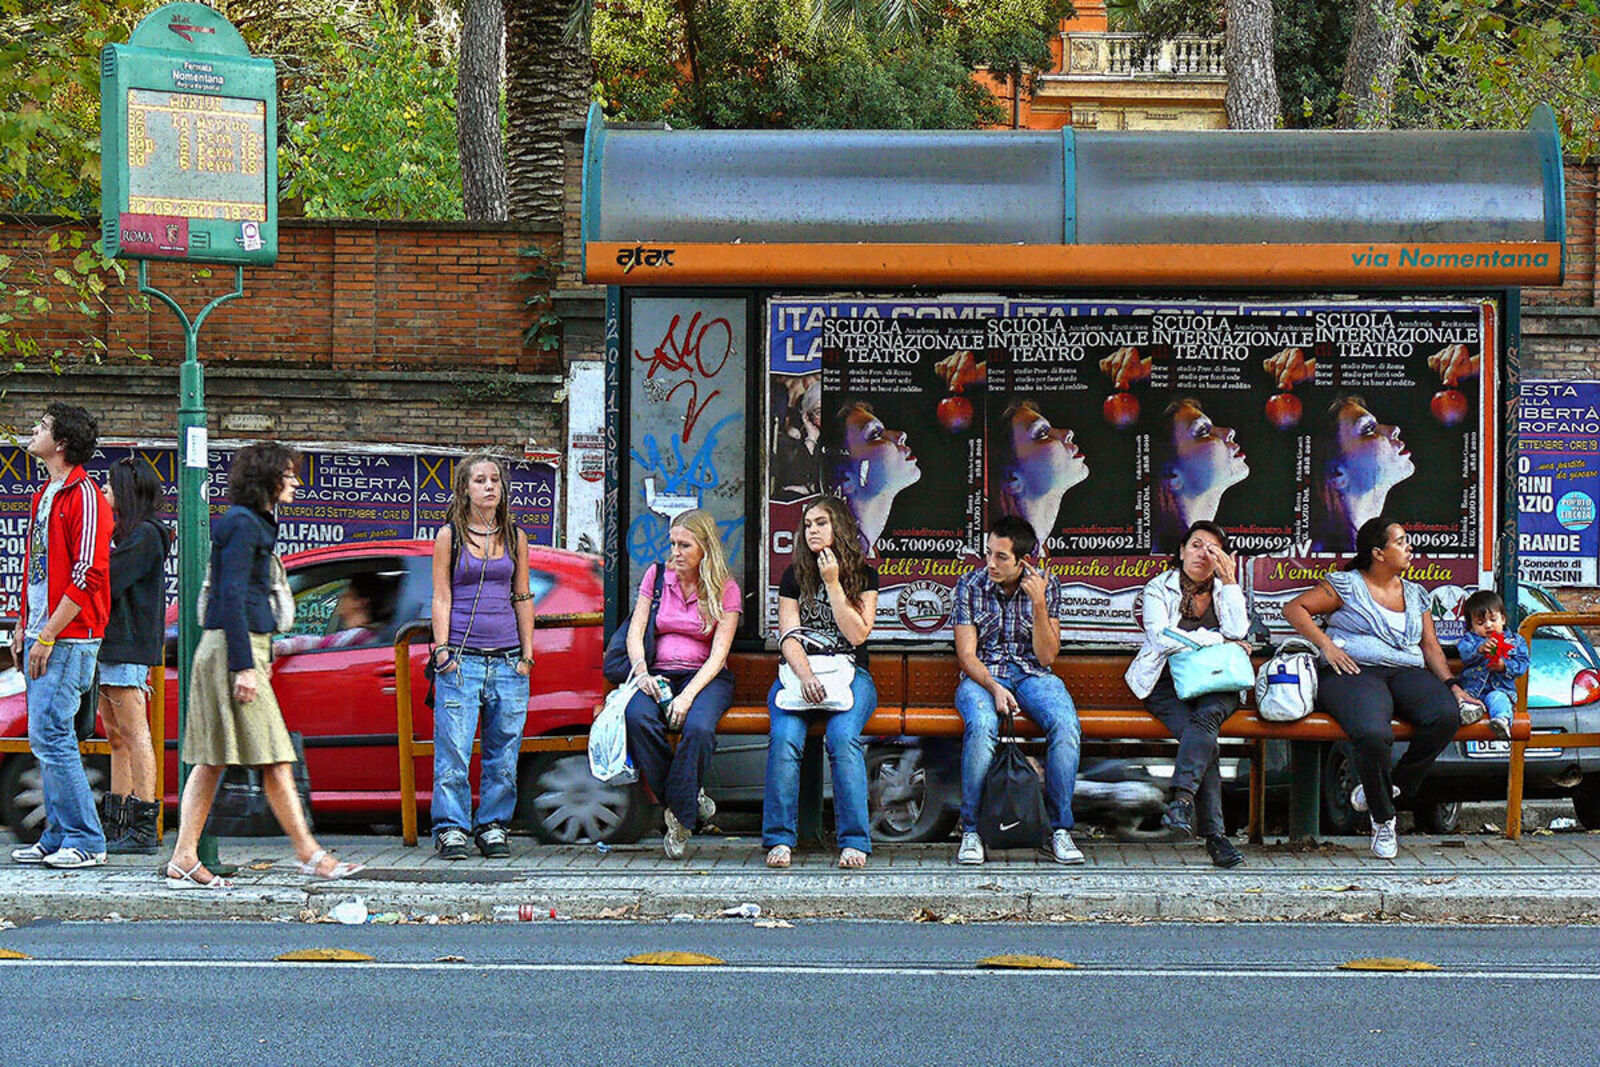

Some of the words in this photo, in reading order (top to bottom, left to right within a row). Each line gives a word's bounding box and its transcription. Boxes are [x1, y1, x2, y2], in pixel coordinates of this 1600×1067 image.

[184, 62, 213, 72] Fermata
[173, 70, 224, 84] Nomentana
[122, 230, 154, 243] ROMA
[616, 248, 675, 274] atac
[1351, 246, 1389, 268] via
[1399, 247, 1550, 268] Nomentana
[824, 319, 901, 335] SCUOLA
[987, 318, 1066, 334] SCUOLA
[1152, 316, 1231, 332] SCUOLA
[1316, 313, 1395, 329] SCUOLA
[823, 333, 984, 350] INTERNAZIONALE
[987, 332, 1149, 348] INTERNAZIONALE
[1151, 330, 1314, 347] INTERNAZIONALE
[1315, 327, 1478, 344] INTERNAZIONALE
[845, 348, 920, 364] TEATRO
[1009, 347, 1085, 362] TEATRO
[1173, 344, 1249, 360] TEATRO
[1337, 342, 1413, 358] TEATRO
[1520, 385, 1578, 397] ESTA
[1519, 398, 1551, 406] ELLA
[1519, 406, 1600, 420] IBERTÀ
[1518, 421, 1600, 433] ROFANO
[1518, 440, 1563, 449] ETTEMBRE
[1569, 440, 1588, 450] ORE
[1589, 440, 1598, 450] 19
[320, 454, 389, 467] FESTA
[320, 467, 364, 476] DELLA
[420, 458, 454, 490] XI
[320, 476, 411, 490] LIBERTÀ
[1518, 476, 1552, 494] RINI
[295, 489, 411, 503] SACROFANO
[418, 492, 431, 502] A
[1518, 495, 1554, 513] AZIO
[315, 507, 326, 517] 23
[382, 510, 401, 520] ORE
[402, 510, 410, 520] 19
[419, 509, 447, 519] VENER
[522, 514, 540, 524] ORE
[541, 513, 549, 524] 19
[277, 523, 344, 542] ALFANO
[877, 538, 963, 552] 06.7009692
[1047, 535, 1134, 550] 06.7009692
[1228, 536, 1292, 550] 7009692
[1519, 534, 1581, 552] RANDE
[1269, 562, 1338, 580] Nemich
[1523, 559, 1569, 568] Concerto
[1571, 559, 1582, 568] di
[1529, 570, 1582, 583] MASINI
